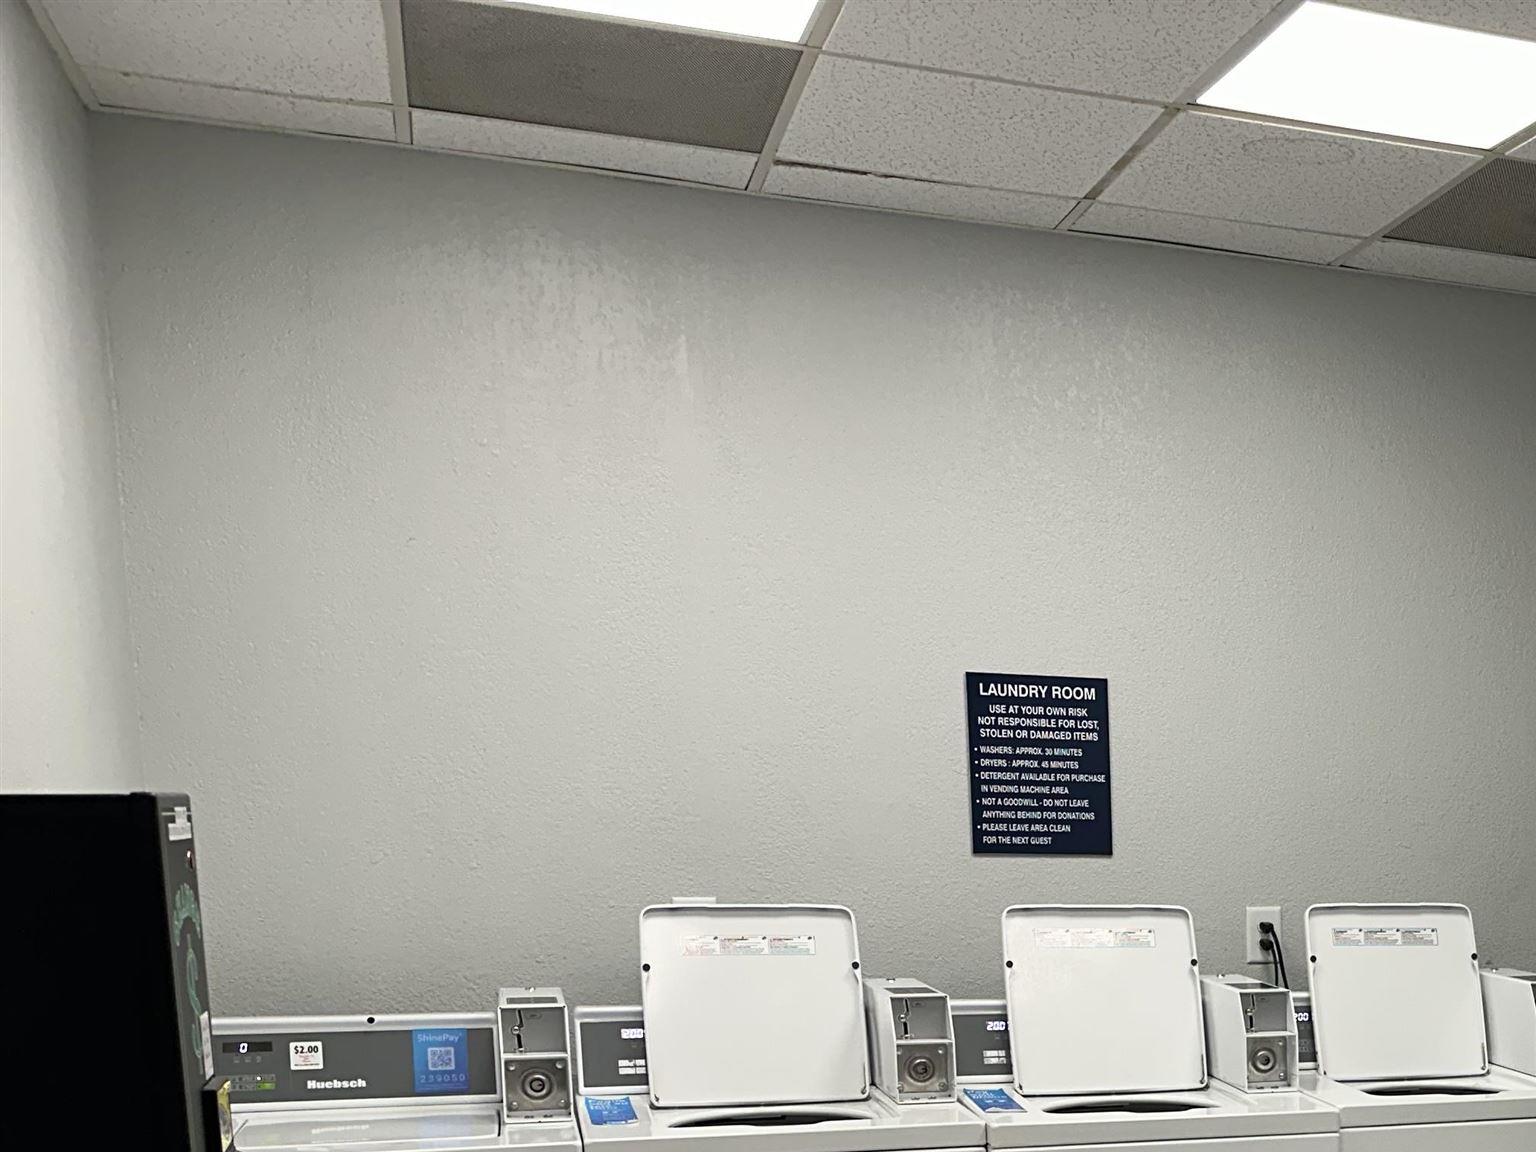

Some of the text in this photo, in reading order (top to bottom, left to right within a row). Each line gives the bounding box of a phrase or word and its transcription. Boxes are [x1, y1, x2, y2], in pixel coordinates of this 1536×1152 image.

[979, 683, 1096, 700] LAUNDRY ROOM
[989, 704, 1088, 717] USE AT YOUR OWN RISK
[978, 716, 1100, 731] NOT RESPONSIBLE FOR LOST,
[979, 728, 1099, 741] STOLEN OR DAMAGED ITEMS
[980, 746, 1083, 757] WASHERS: APPROX. 30 MINUTES
[1011, 760, 1040, 768] APPROX.
[1041, 760, 1049, 768] 45
[1050, 761, 1079, 769] MINUTES
[980, 771, 1106, 783] DETERGENT AVAILABLE FOR PURCHASE
[980, 785, 1069, 795] IN VENDING MACHINE AREA
[981, 798, 996, 806] NOT
[997, 798, 1002, 806] A
[1003, 798, 1038, 807] GOODWILL
[1043, 799, 1053, 807] DO
[1054, 799, 1068, 807] NOT
[1069, 799, 1089, 808] LEAVE
[982, 810, 1095, 820] ANYTHING BEHIND FOR DONATIONS
[982, 823, 1071, 833] PLEASE LEAVE AREA CLEAN
[982, 836, 1052, 845] FOR THE NEXT GUEST
[294, 1045, 319, 1054] $2.00
[307, 1079, 366, 1089] Huebsch
